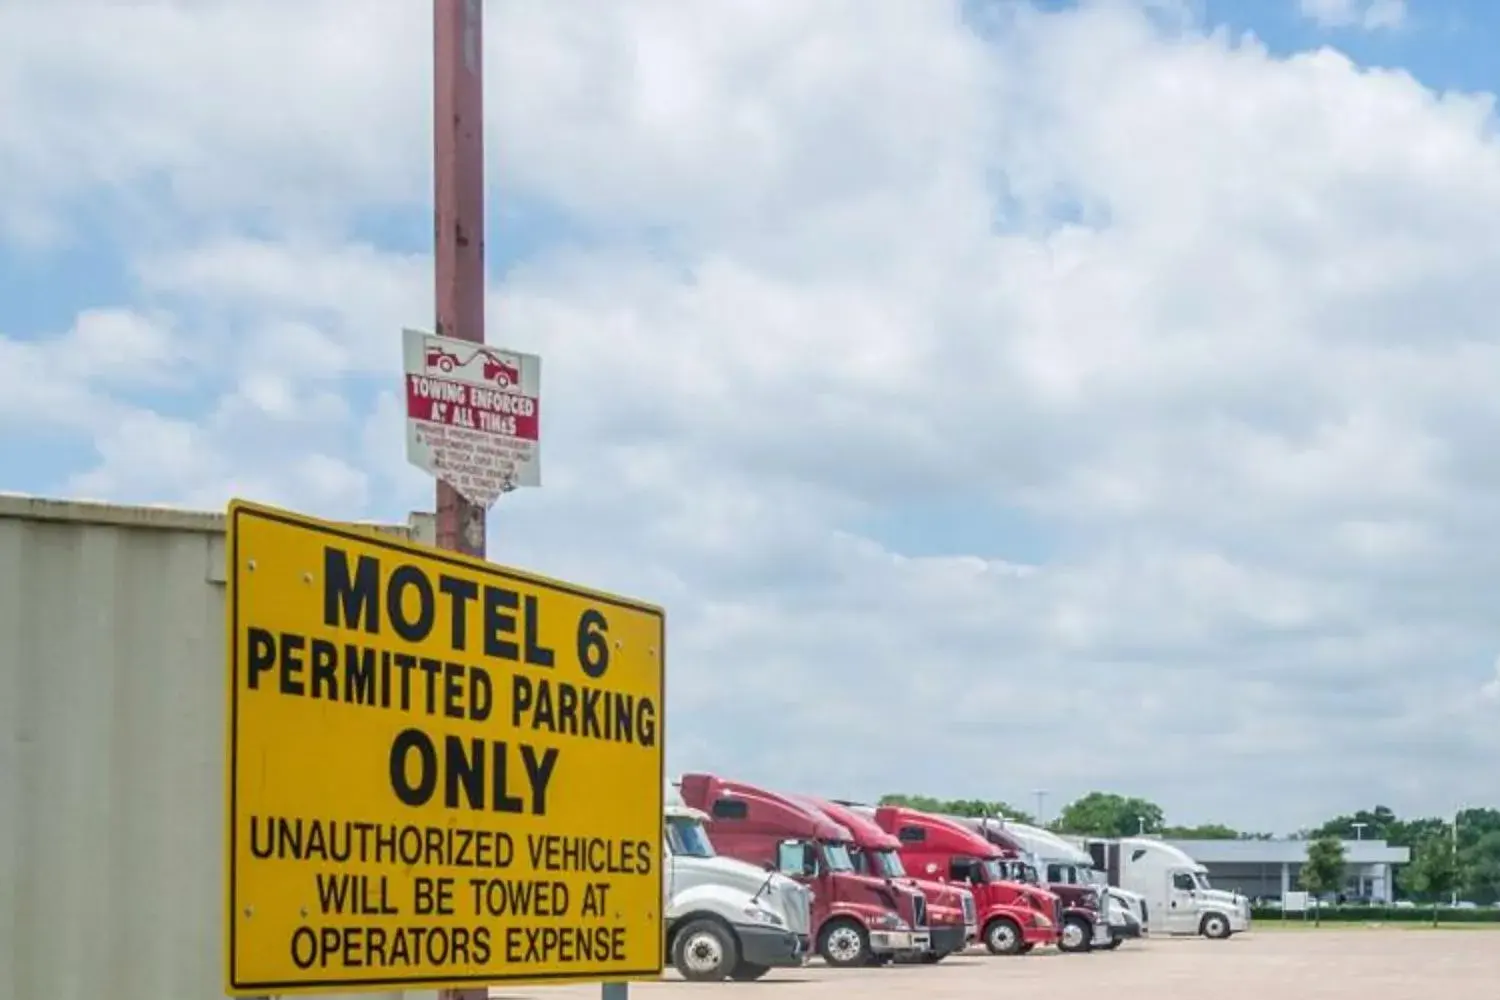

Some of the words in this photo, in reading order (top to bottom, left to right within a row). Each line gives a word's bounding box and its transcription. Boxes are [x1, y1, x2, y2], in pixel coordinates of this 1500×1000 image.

[411, 375, 465, 404] TOWING
[470, 387, 533, 417] ENFORCED
[431, 401, 448, 423] AT
[452, 405, 475, 427] ALL
[478, 410, 516, 435] TIMES
[323, 546, 555, 668] MOTEL
[577, 609, 609, 679] 6
[247, 626, 493, 722] PERMITTED
[512, 674, 655, 747] PARKING
[389, 727, 560, 816] ONLY
[250, 815, 514, 868] UNAUTHORIZED
[527, 835, 651, 875] VEHICLES
[316, 873, 399, 915] WILL
[414, 877, 455, 916] BE
[469, 878, 569, 917] TOWED
[581, 883, 611, 917] AT
[290, 925, 491, 970] OPERATORS
[506, 926, 626, 963] EXPENSE
